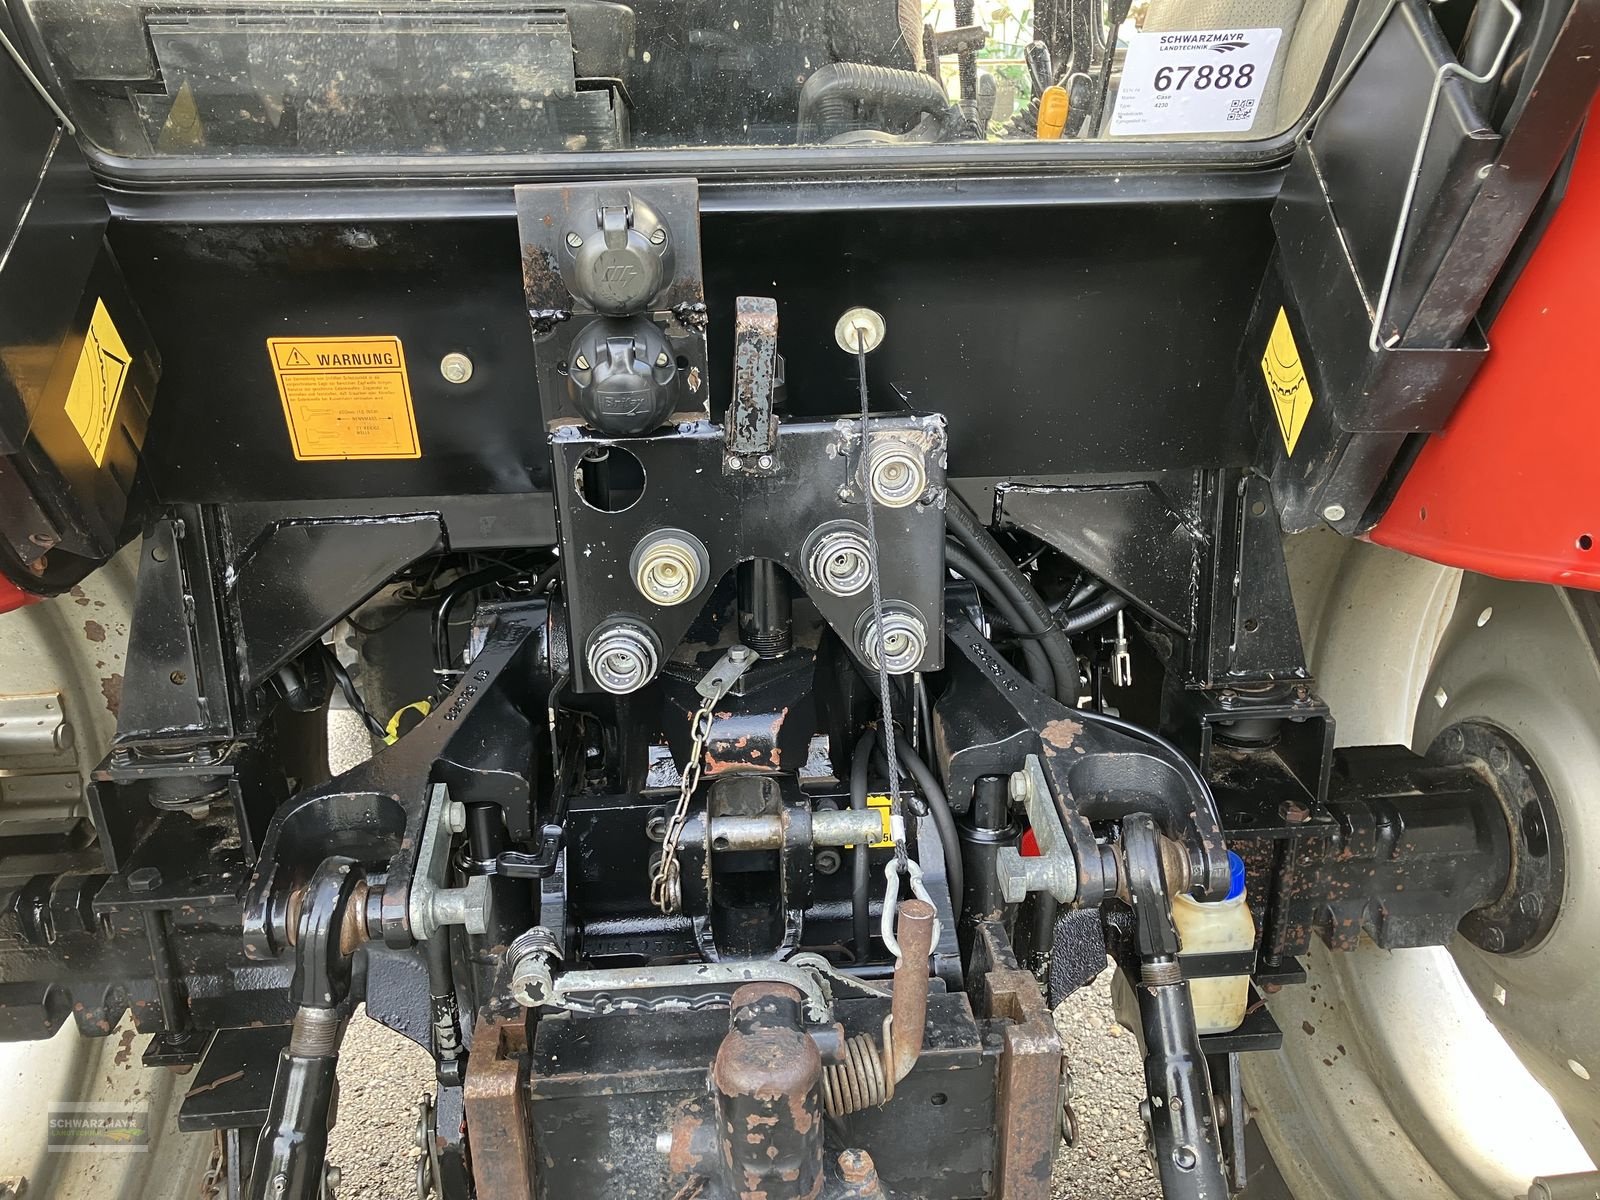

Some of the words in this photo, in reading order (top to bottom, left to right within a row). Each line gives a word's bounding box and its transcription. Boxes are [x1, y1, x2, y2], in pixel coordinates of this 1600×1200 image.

[1160, 33, 1245, 44] SCHWARZMAYR
[1154, 63, 1256, 92] 67888
[316, 352, 393, 366] WARNUNG
